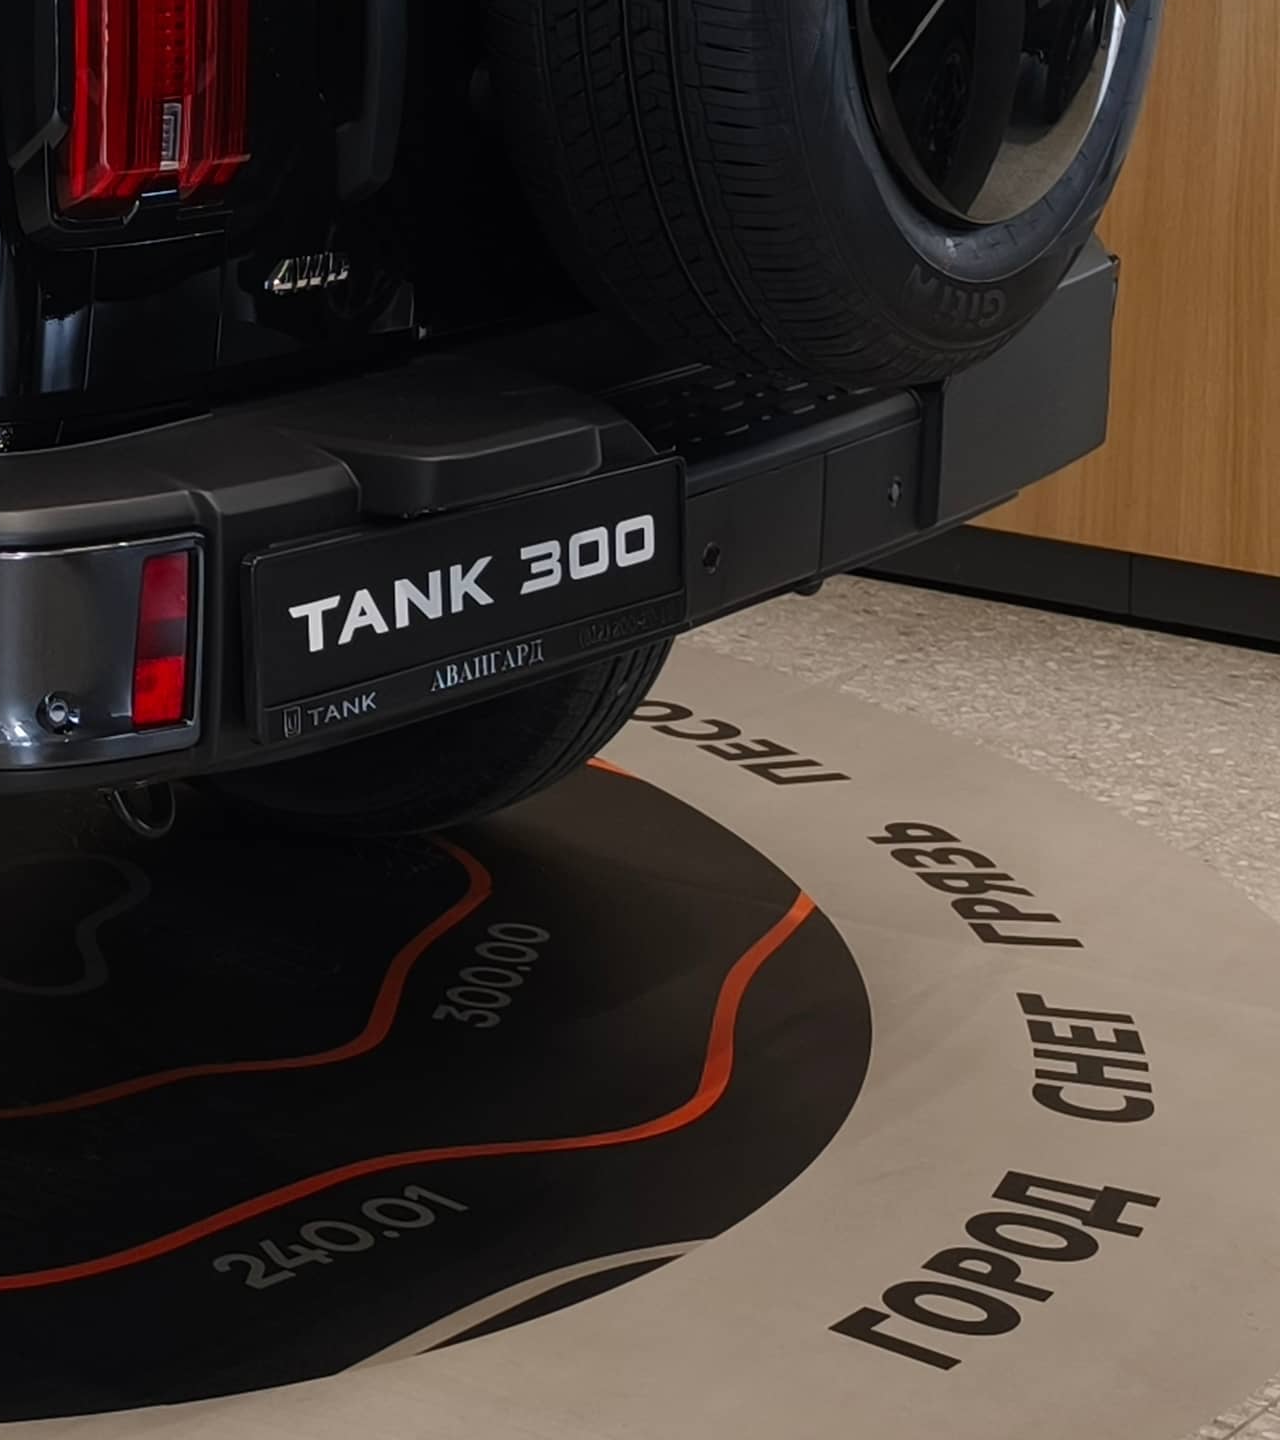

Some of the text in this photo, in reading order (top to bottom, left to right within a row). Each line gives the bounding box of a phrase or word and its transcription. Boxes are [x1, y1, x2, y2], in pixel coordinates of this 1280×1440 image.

[288, 555, 496, 654] TANK
[519, 513, 656, 596] 300
[306, 691, 378, 727] TANK
[867, 821, 1085, 948] ГРЯЗЬ
[433, 921, 552, 1030] 300.00
[1017, 993, 1155, 1123] СНЕГ
[213, 1184, 468, 1290] 240.01
[827, 1170, 1161, 1371] ГОРОД
